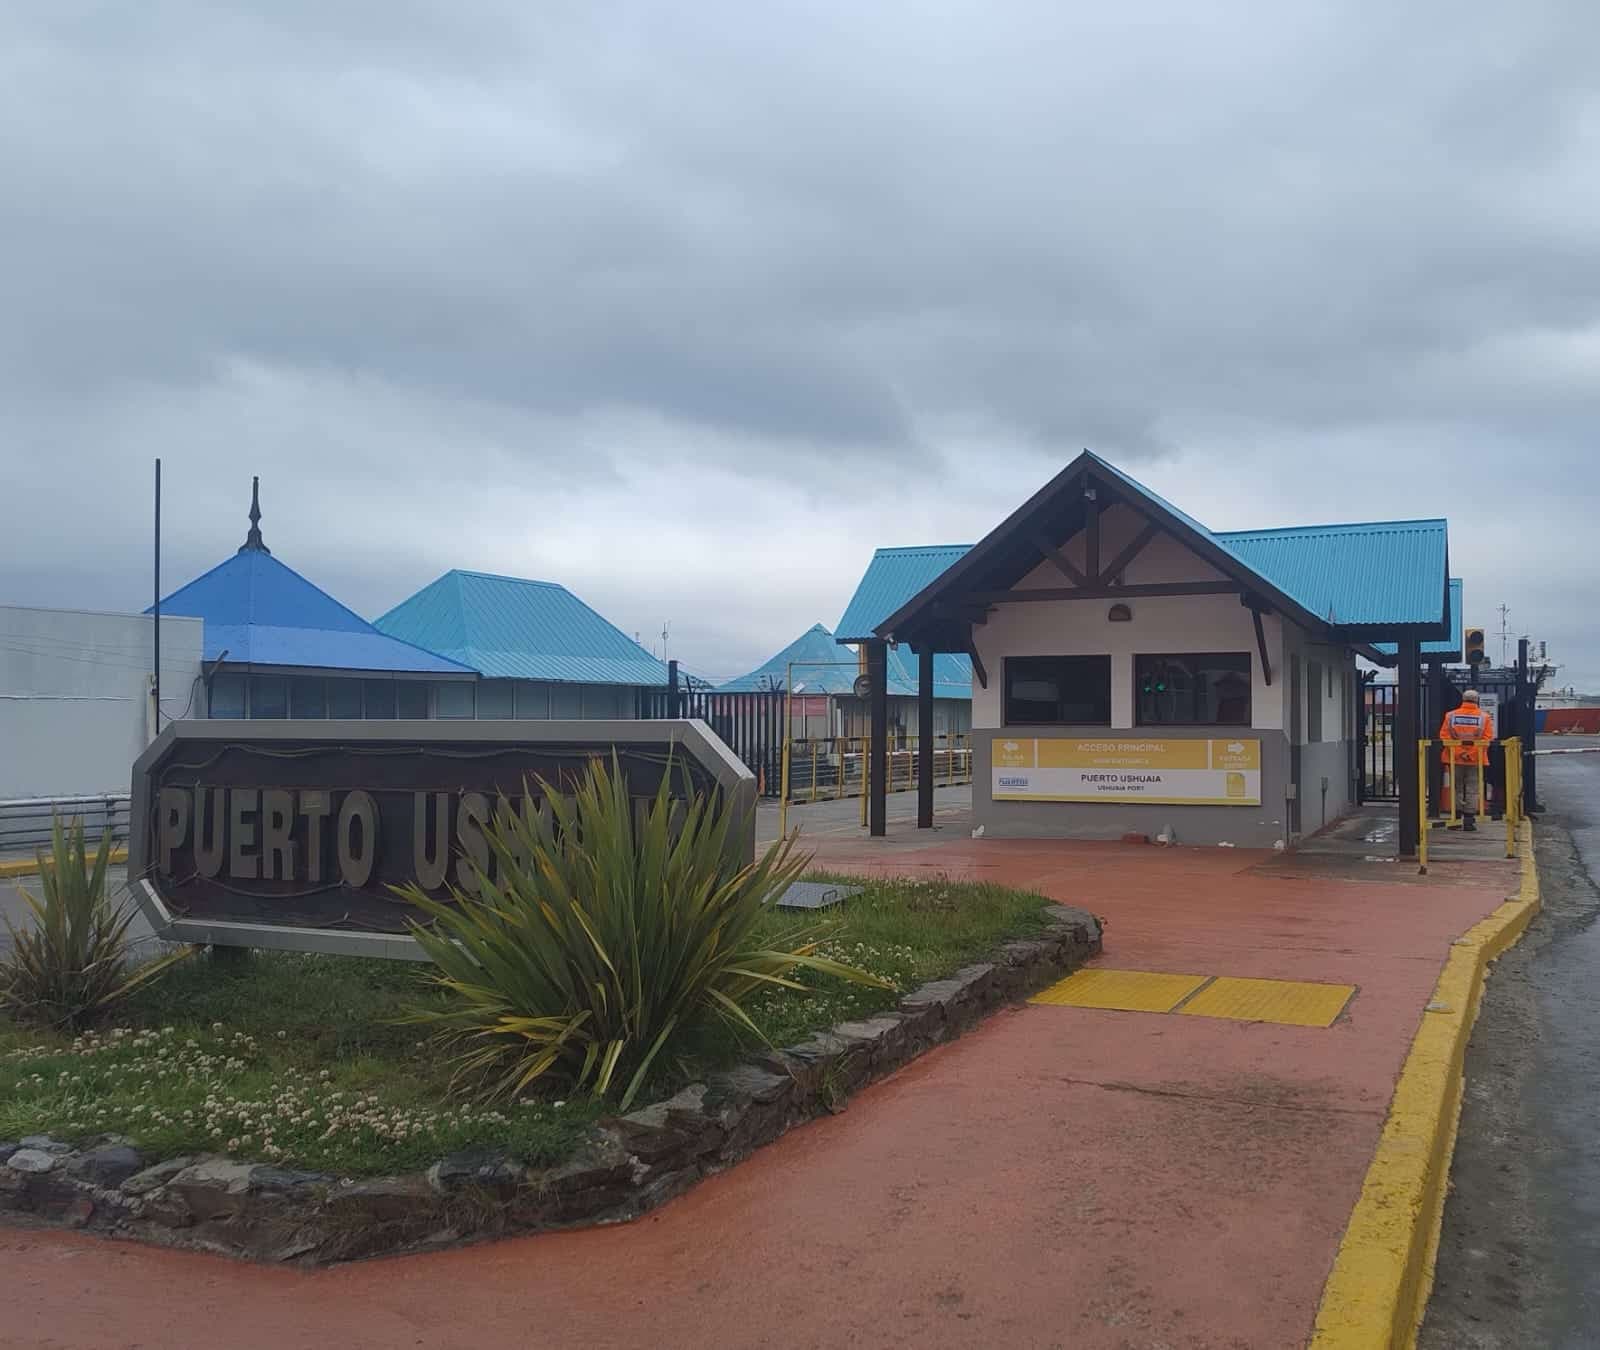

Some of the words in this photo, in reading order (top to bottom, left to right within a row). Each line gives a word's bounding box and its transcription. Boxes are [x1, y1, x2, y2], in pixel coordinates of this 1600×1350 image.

[1077, 743, 1116, 752] ACCESO
[1118, 743, 1166, 753] PRINCIPAL
[1081, 773, 1118, 782] PUERTO
[1120, 774, 1161, 783] USHUAIA
[159, 787, 376, 888] PUERTO
